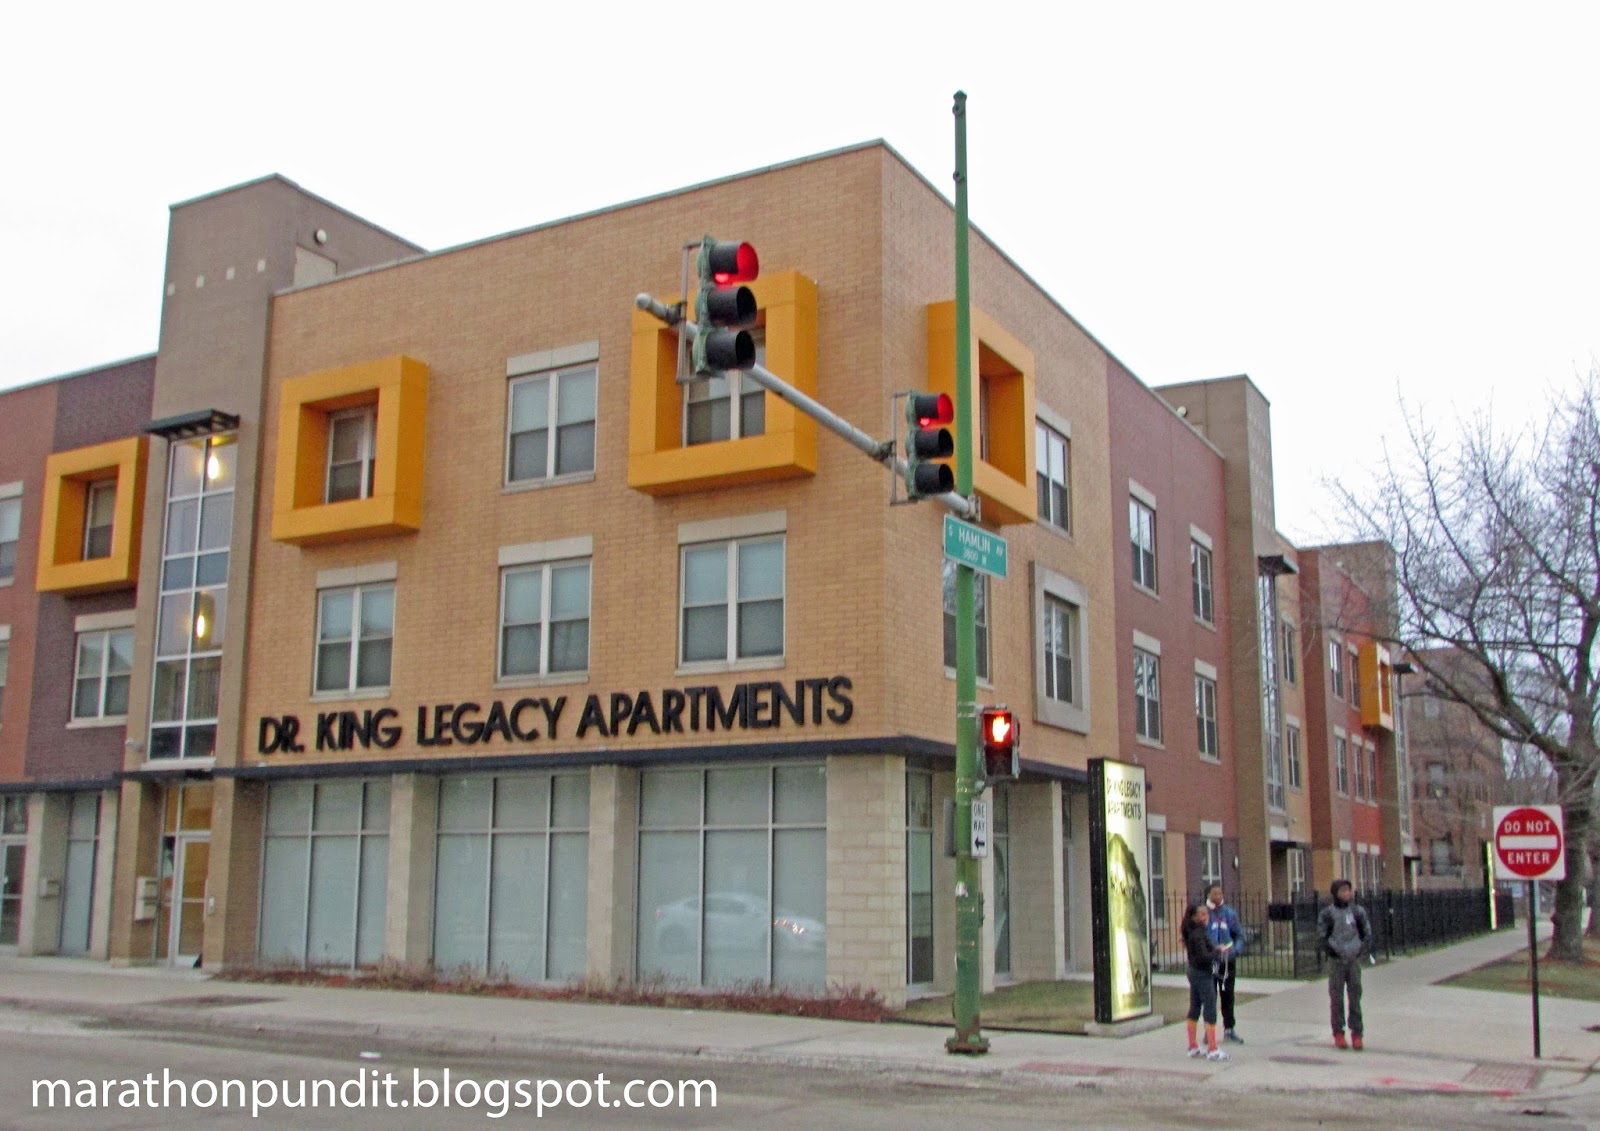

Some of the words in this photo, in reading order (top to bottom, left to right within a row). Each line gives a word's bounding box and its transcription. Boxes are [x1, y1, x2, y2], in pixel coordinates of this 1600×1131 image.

[958, 526, 991, 553] HAMLIN
[258, 714, 304, 755] DR.
[315, 707, 403, 752] KING
[416, 697, 568, 748] LEGACY
[575, 676, 854, 738] APARTMENTS
[973, 803, 985, 818] ONE
[973, 820, 985, 832] WAY
[1504, 820, 1520, 833] DO
[1526, 820, 1551, 833] NOT
[1507, 851, 1550, 865] ENTER
